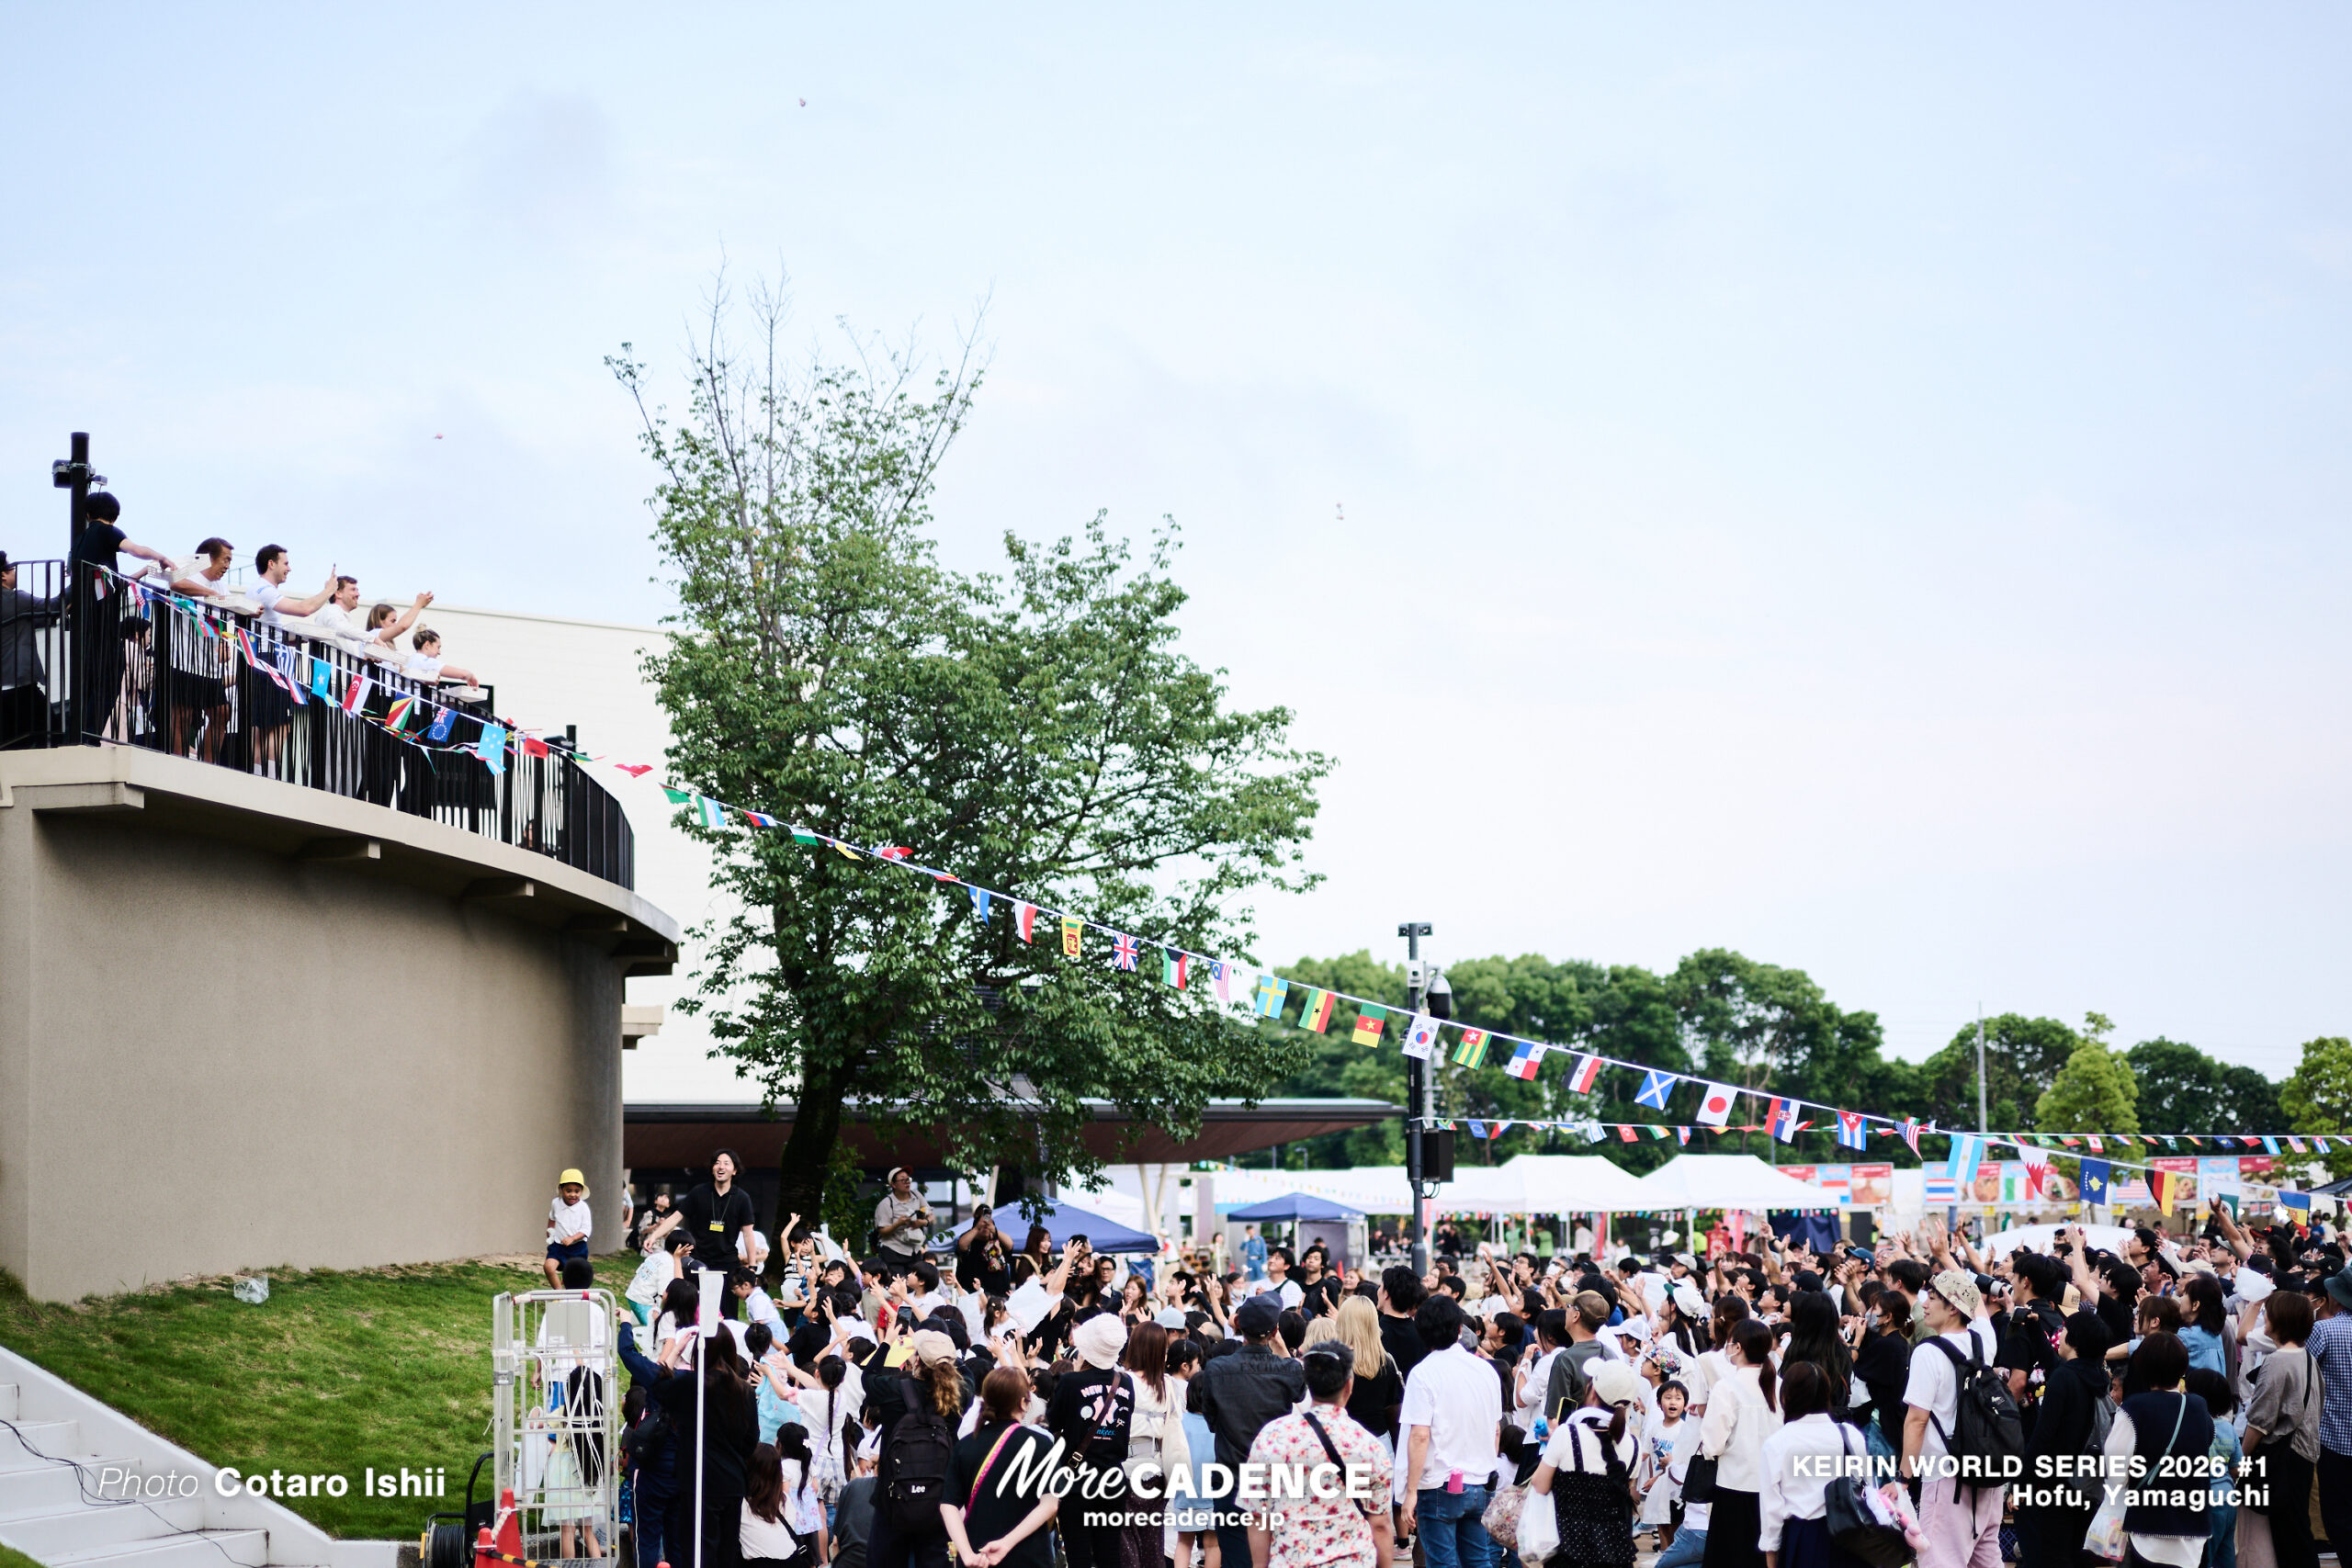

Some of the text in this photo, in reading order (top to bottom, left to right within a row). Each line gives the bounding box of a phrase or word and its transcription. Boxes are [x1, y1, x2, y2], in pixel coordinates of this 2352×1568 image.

[1080, 1384, 1130, 1400] NEW YRK
[911, 1484, 926, 1493] Lee
